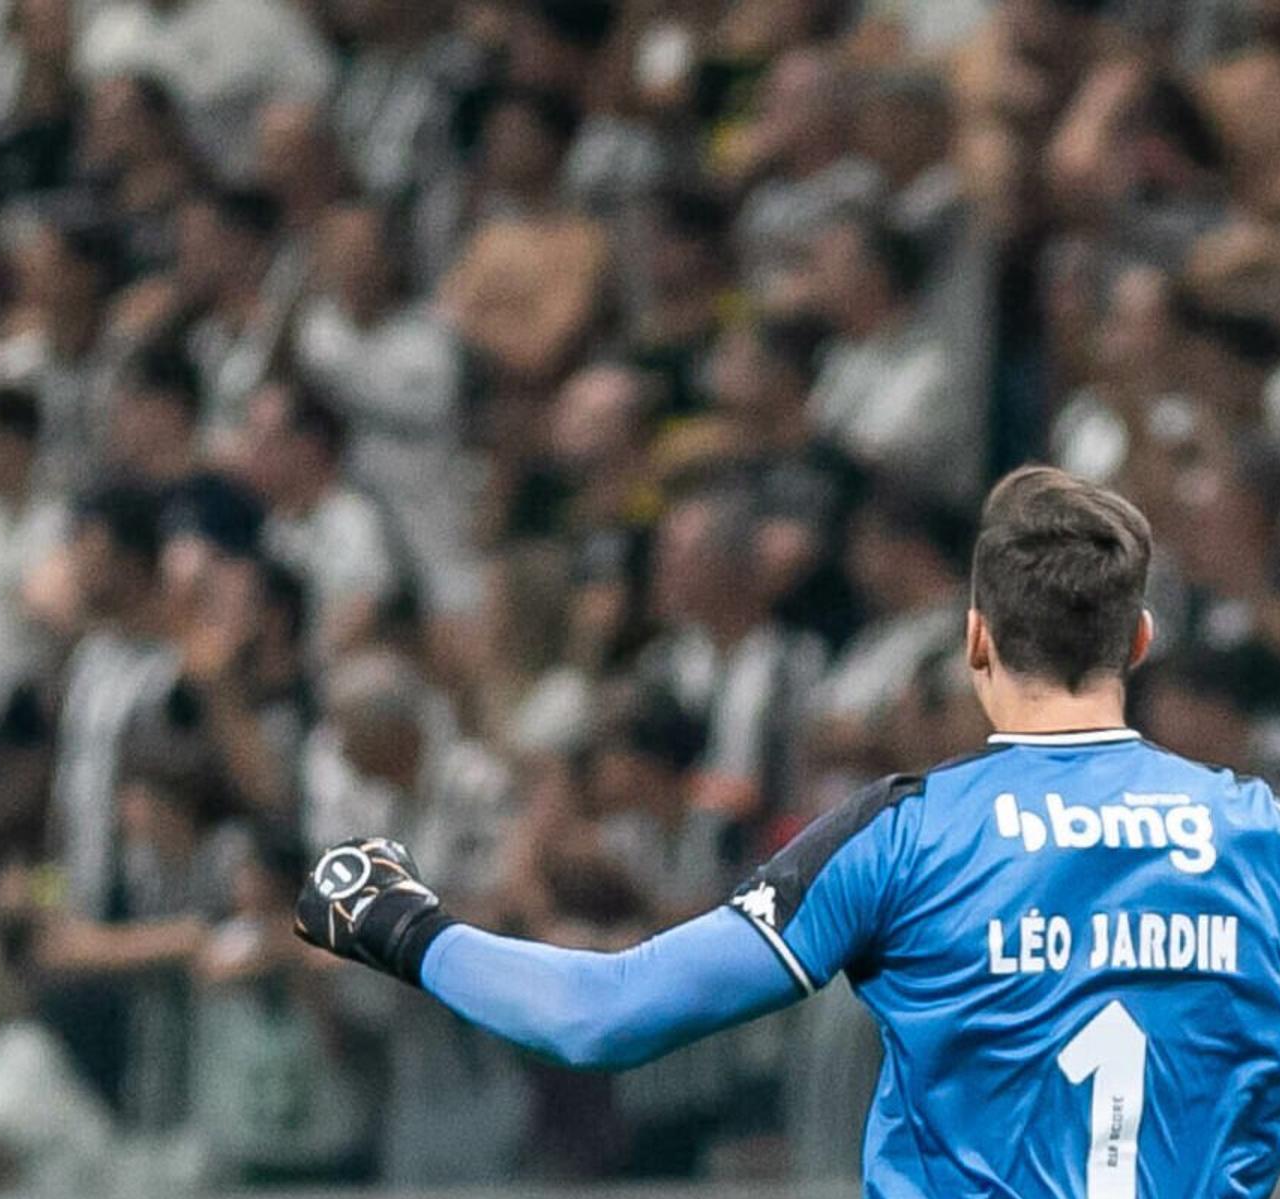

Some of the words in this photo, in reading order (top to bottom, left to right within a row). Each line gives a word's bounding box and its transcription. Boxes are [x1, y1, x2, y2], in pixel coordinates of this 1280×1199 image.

[1045, 793, 1217, 874] bmg
[988, 908, 1070, 974] LÉO
[1089, 913, 1238, 974] JARDIM
